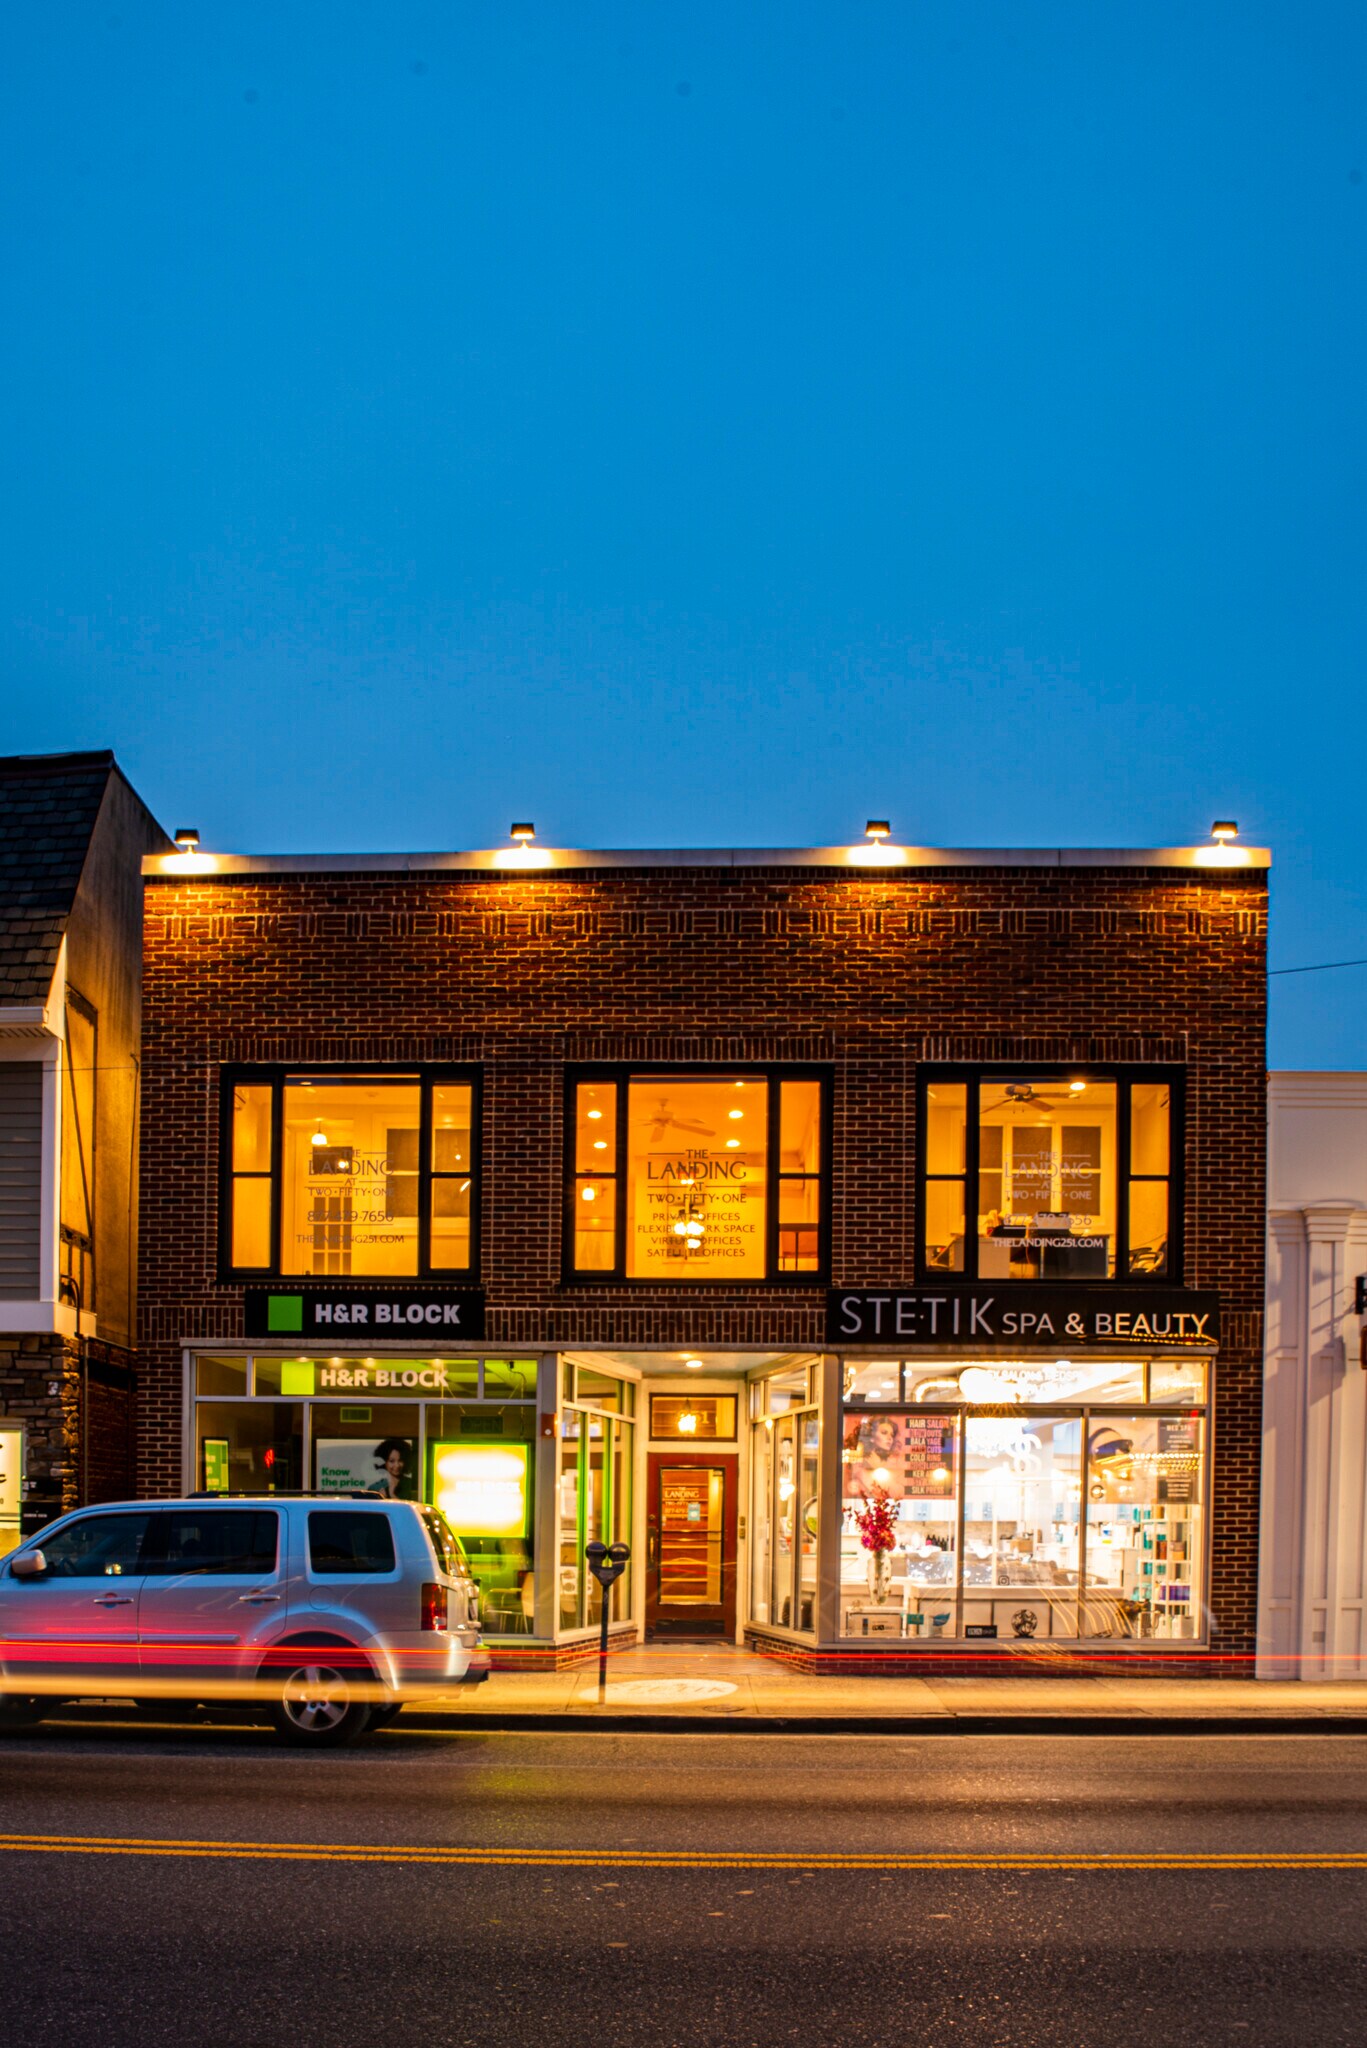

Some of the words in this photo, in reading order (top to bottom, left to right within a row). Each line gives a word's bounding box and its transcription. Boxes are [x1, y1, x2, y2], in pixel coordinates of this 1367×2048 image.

[686, 1149, 709, 1159] THE
[1038, 1151, 1058, 1160] THE
[309, 1160, 395, 1176] LANDING
[648, 1161, 747, 1180] LANDING
[1004, 1162, 1093, 1179] LANDING
[344, 1178, 358, 1186] AT
[689, 1182, 704, 1192] AT
[700, 1213, 741, 1221] OFFICES
[724, 1225, 756, 1233] SPACE
[700, 1237, 741, 1245] OFFICES
[993, 1238, 1104, 1248] THELANDING251.COM
[647, 1249, 700, 1257] SATELLITE
[703, 1249, 746, 1257] OFFICES
[315, 1304, 368, 1323] H&R
[375, 1304, 460, 1324] BLOCK
[1002, 1313, 1055, 1335] SPA
[1065, 1313, 1084, 1335] &
[1095, 1313, 1210, 1335] BEAUTY
[321, 1369, 369, 1387] H&R
[375, 1369, 449, 1388] BLOCK
[909, 1419, 926, 1428] HAIR
[926, 1419, 949, 1429] SALON
[321, 1467, 350, 1476] Know
[321, 1478, 337, 1486] the
[340, 1478, 366, 1488] price
[665, 1490, 700, 1498] LANDING
[911, 1486, 925, 1494] SILK
[926, 1486, 944, 1494] PRESS
